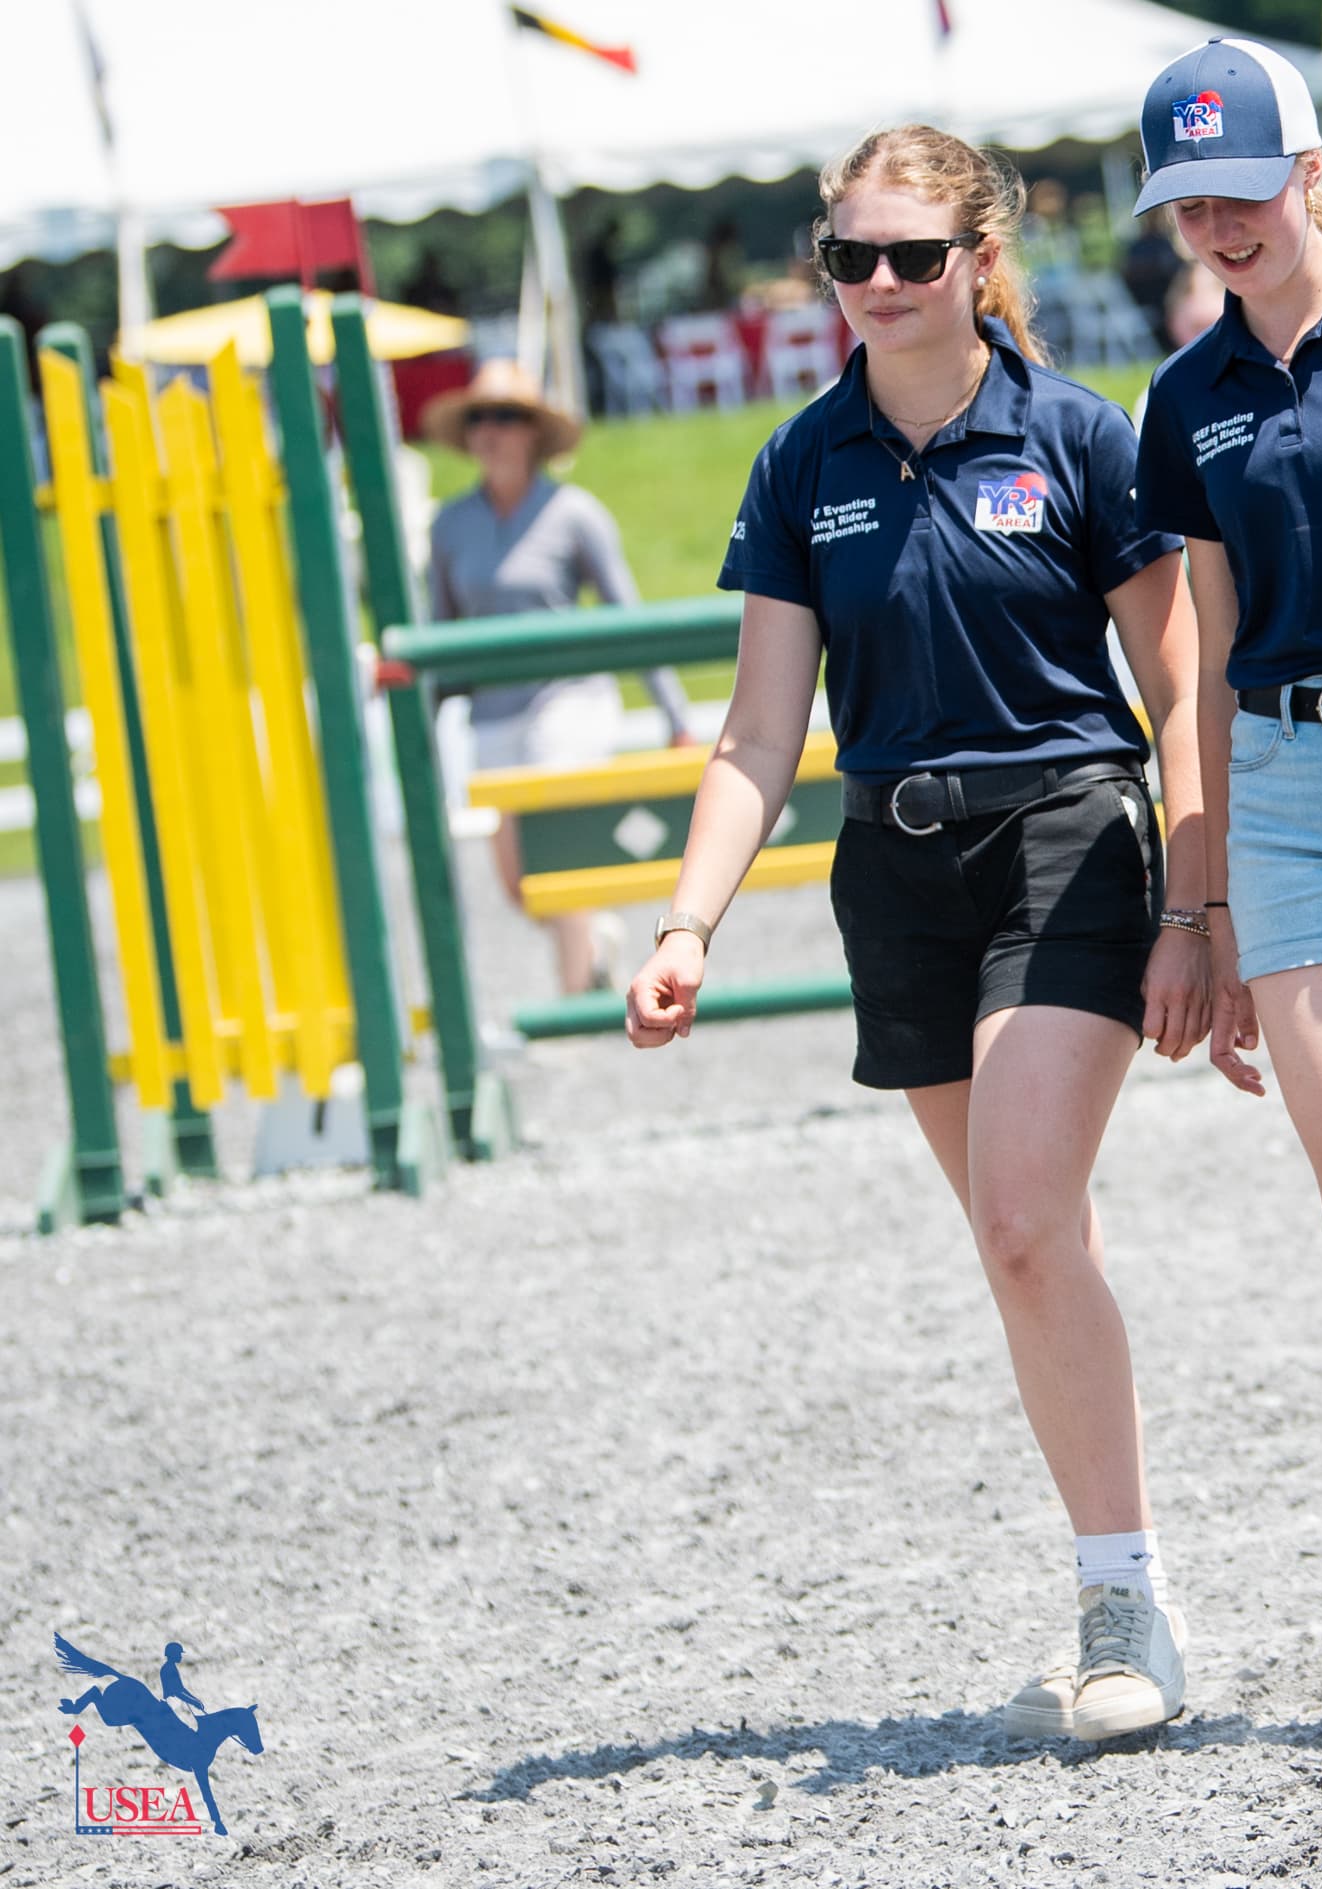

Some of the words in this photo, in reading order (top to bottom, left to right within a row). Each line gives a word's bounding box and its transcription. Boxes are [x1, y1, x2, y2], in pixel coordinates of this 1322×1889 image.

[1173, 103, 1210, 128] YR
[1189, 127, 1216, 137] AREA
[1211, 412, 1254, 433] Eventing
[1220, 425, 1246, 441] Rider
[823, 498, 876, 517] Eventing
[979, 486, 1028, 515] YR
[838, 511, 869, 526] Rider
[996, 518, 1031, 528] AREA
